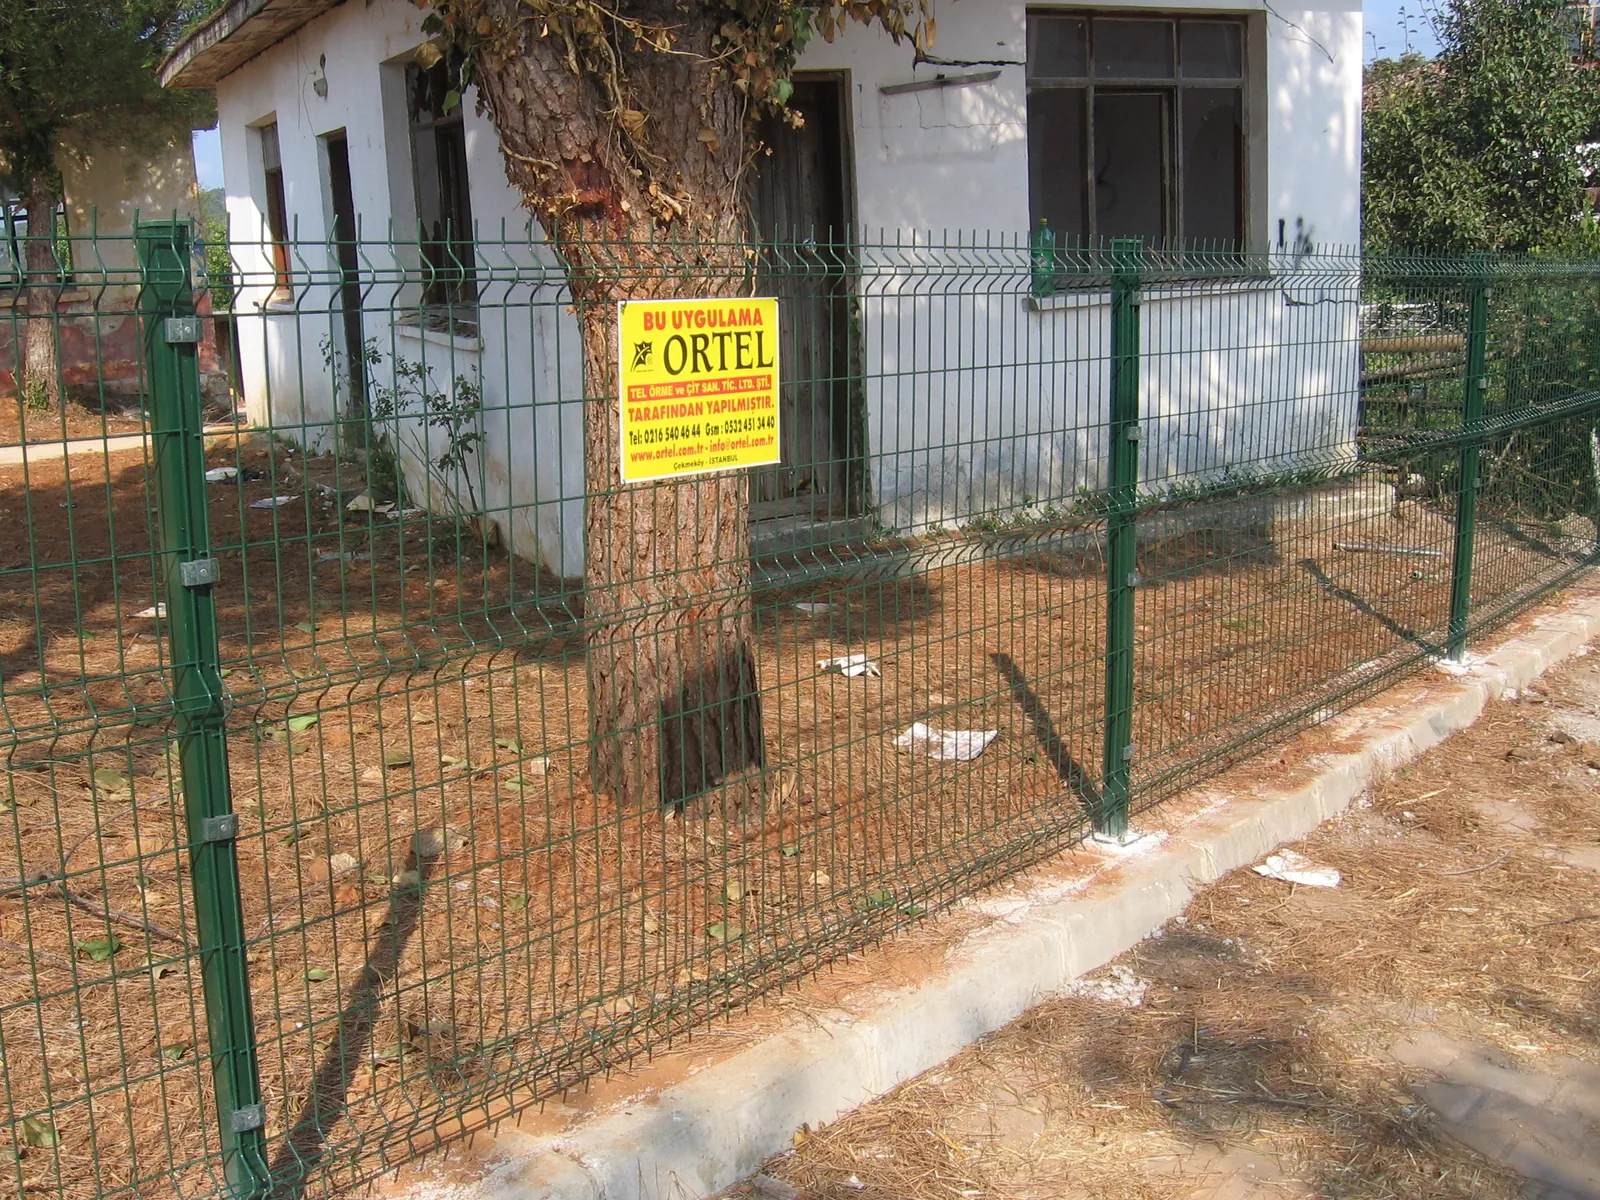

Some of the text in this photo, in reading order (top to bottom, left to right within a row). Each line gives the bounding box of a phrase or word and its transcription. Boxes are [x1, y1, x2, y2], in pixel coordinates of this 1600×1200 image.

[643, 308, 763, 331] BU UYGULAMA
[663, 330, 774, 376] ORTEL
[630, 375, 770, 399] TEL ÖRME ve ÇİT SAN. TİC. LTD. ŞTİ.
[628, 401, 703, 422] TARAFINDAN
[629, 429, 643, 445] Tel:
[644, 428, 663, 444] 0216
[665, 425, 680, 442] 540
[680, 424, 690, 439] 46
[691, 423, 701, 438] 44
[724, 419, 742, 434] 0532
[743, 417, 756, 432] 451
[757, 416, 766, 430] 34
[766, 415, 775, 429] 40
[630, 442, 704, 462] www.ortel.com.tr
[709, 433, 774, 453] info@ortel.com.tr
